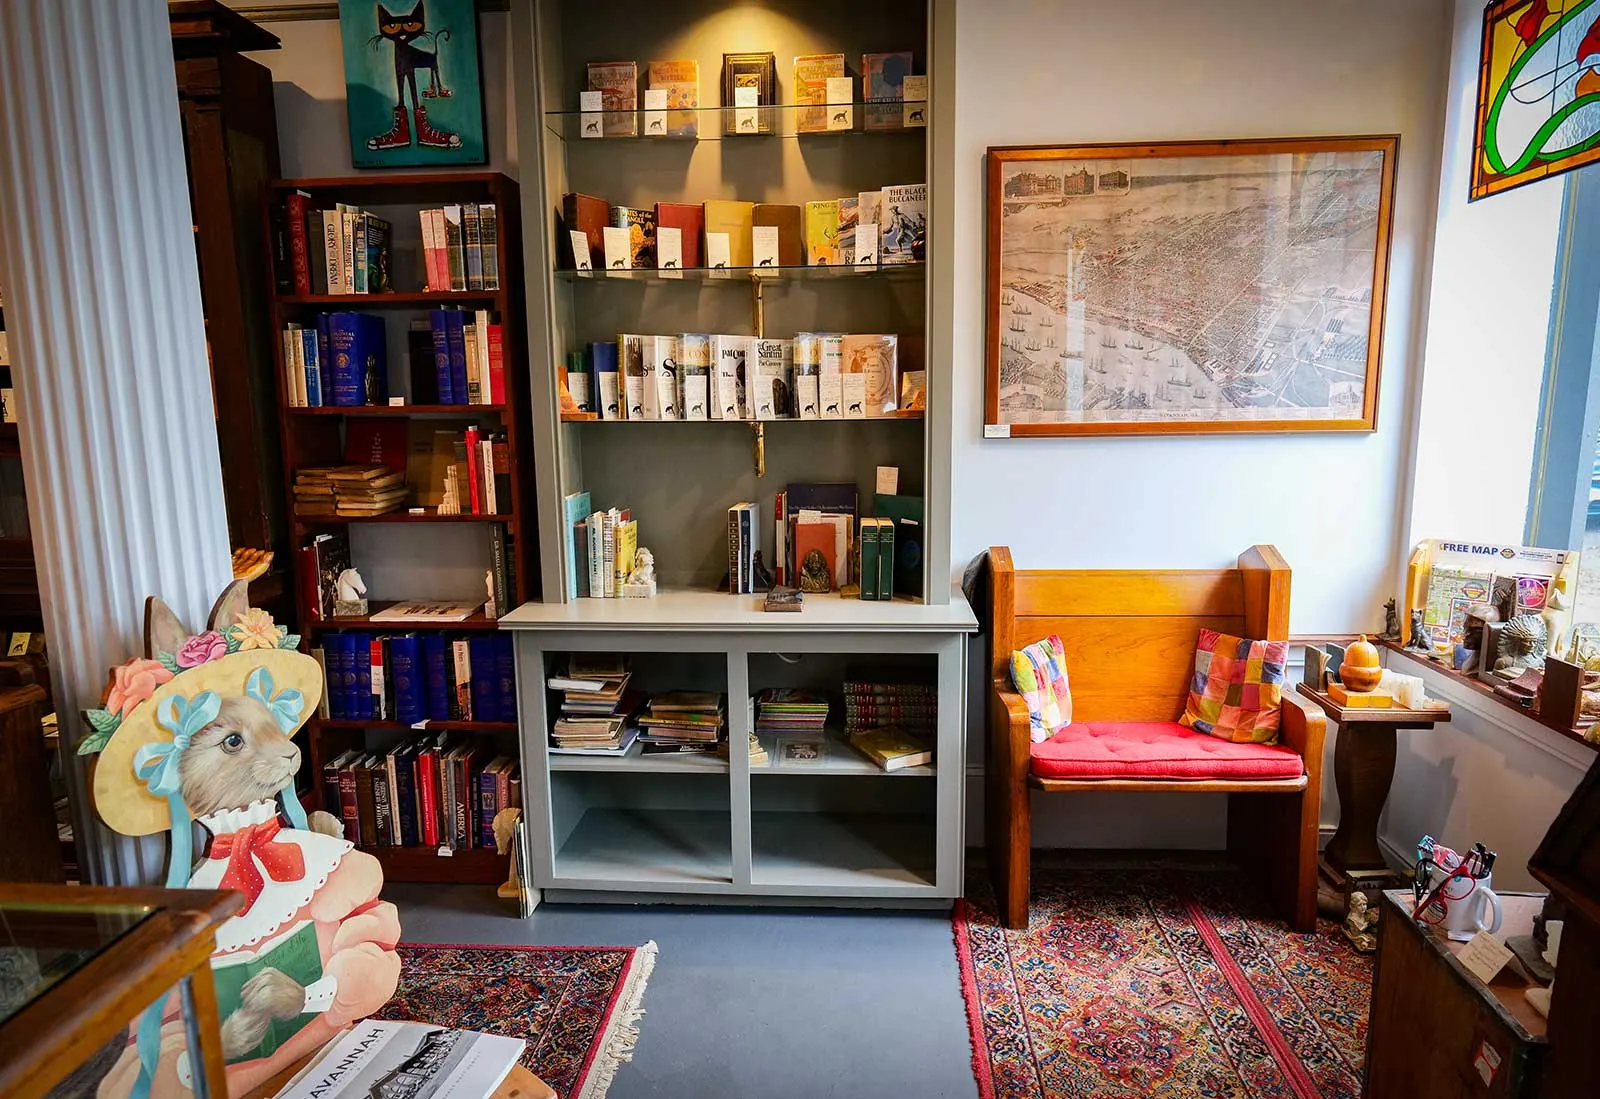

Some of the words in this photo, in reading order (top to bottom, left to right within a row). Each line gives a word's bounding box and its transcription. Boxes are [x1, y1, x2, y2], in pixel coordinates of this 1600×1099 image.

[812, 202, 830, 210] KING
[328, 258, 338, 285] DREAM
[761, 341, 782, 352] Great
[758, 349, 782, 359] Santini
[1443, 543, 1469, 553] FREE
[1471, 545, 1499, 556] MAP
[456, 801, 466, 840] AMERICA
[304, 1028, 385, 1099] AVANNAH
